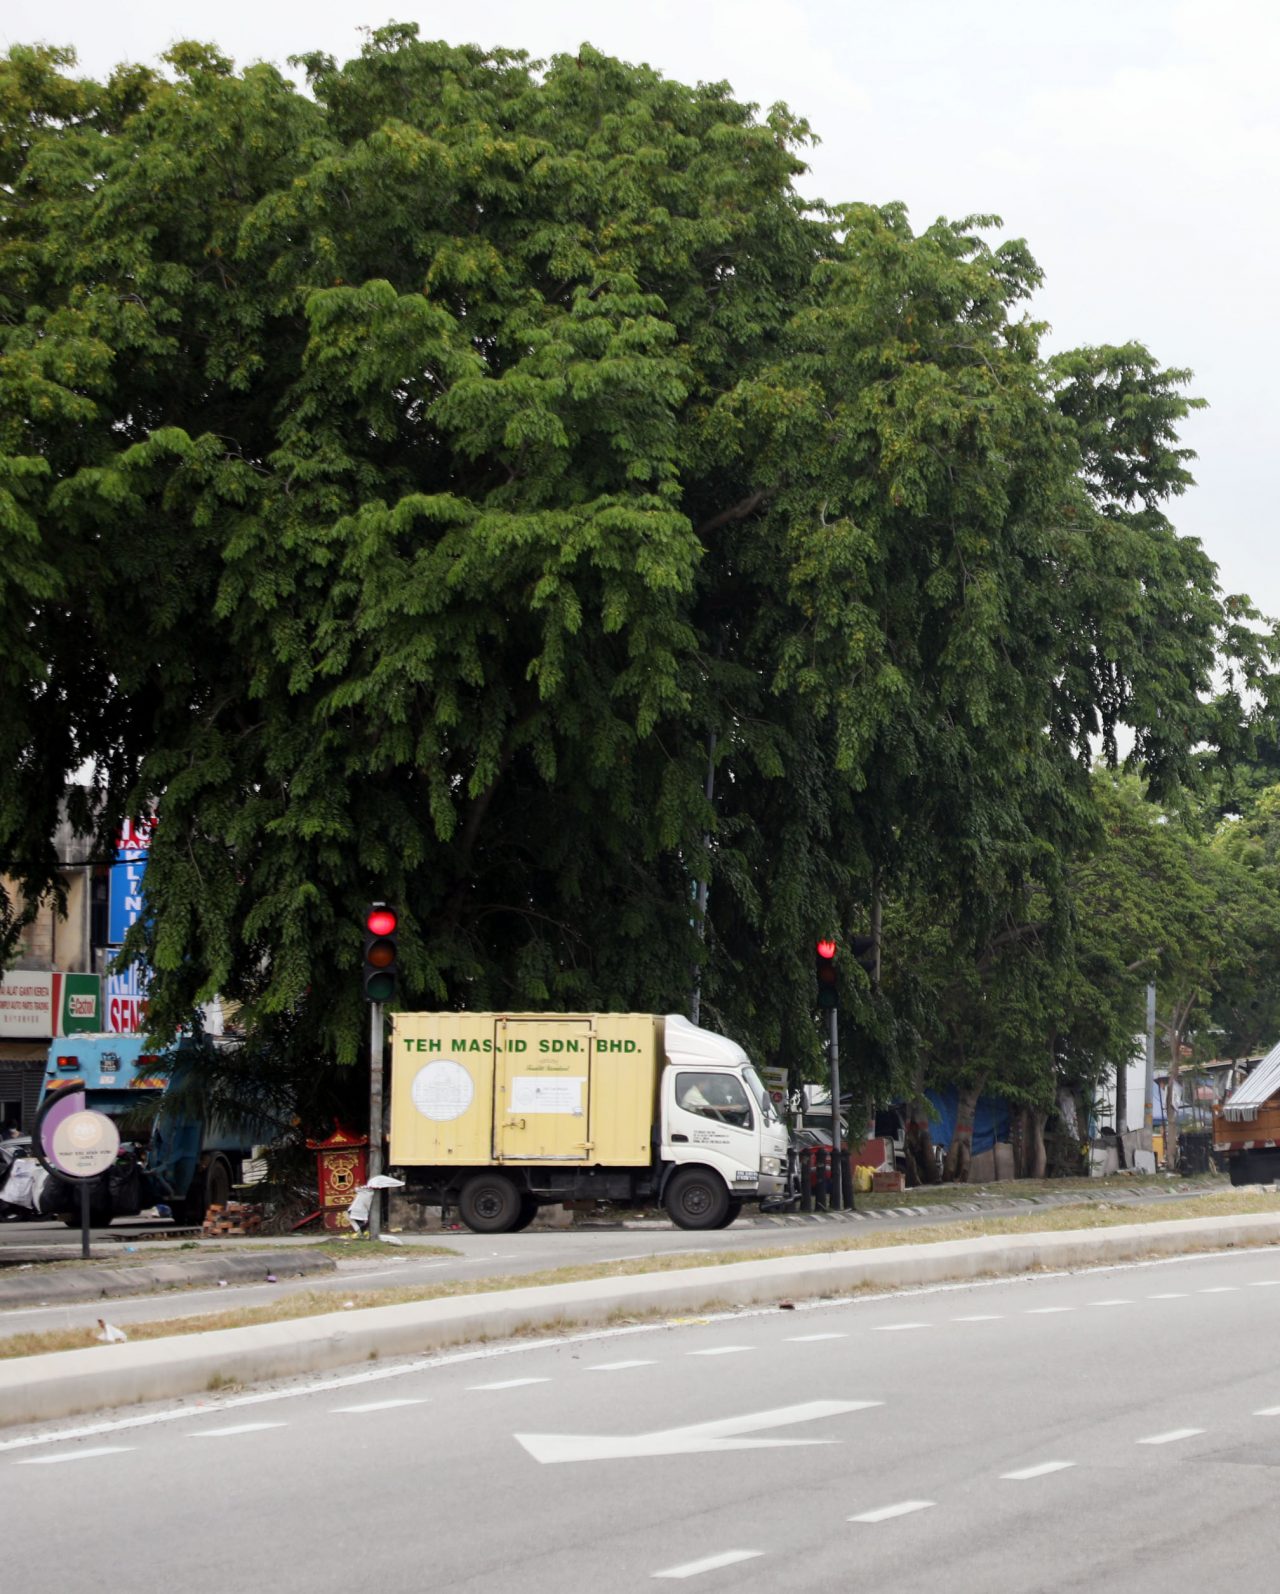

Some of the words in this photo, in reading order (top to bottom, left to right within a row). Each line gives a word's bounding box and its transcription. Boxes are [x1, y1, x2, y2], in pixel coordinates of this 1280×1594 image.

[403, 1038, 442, 1053] TEH
[539, 1039, 585, 1053] SDN.
[596, 1039, 642, 1053] BHD.
